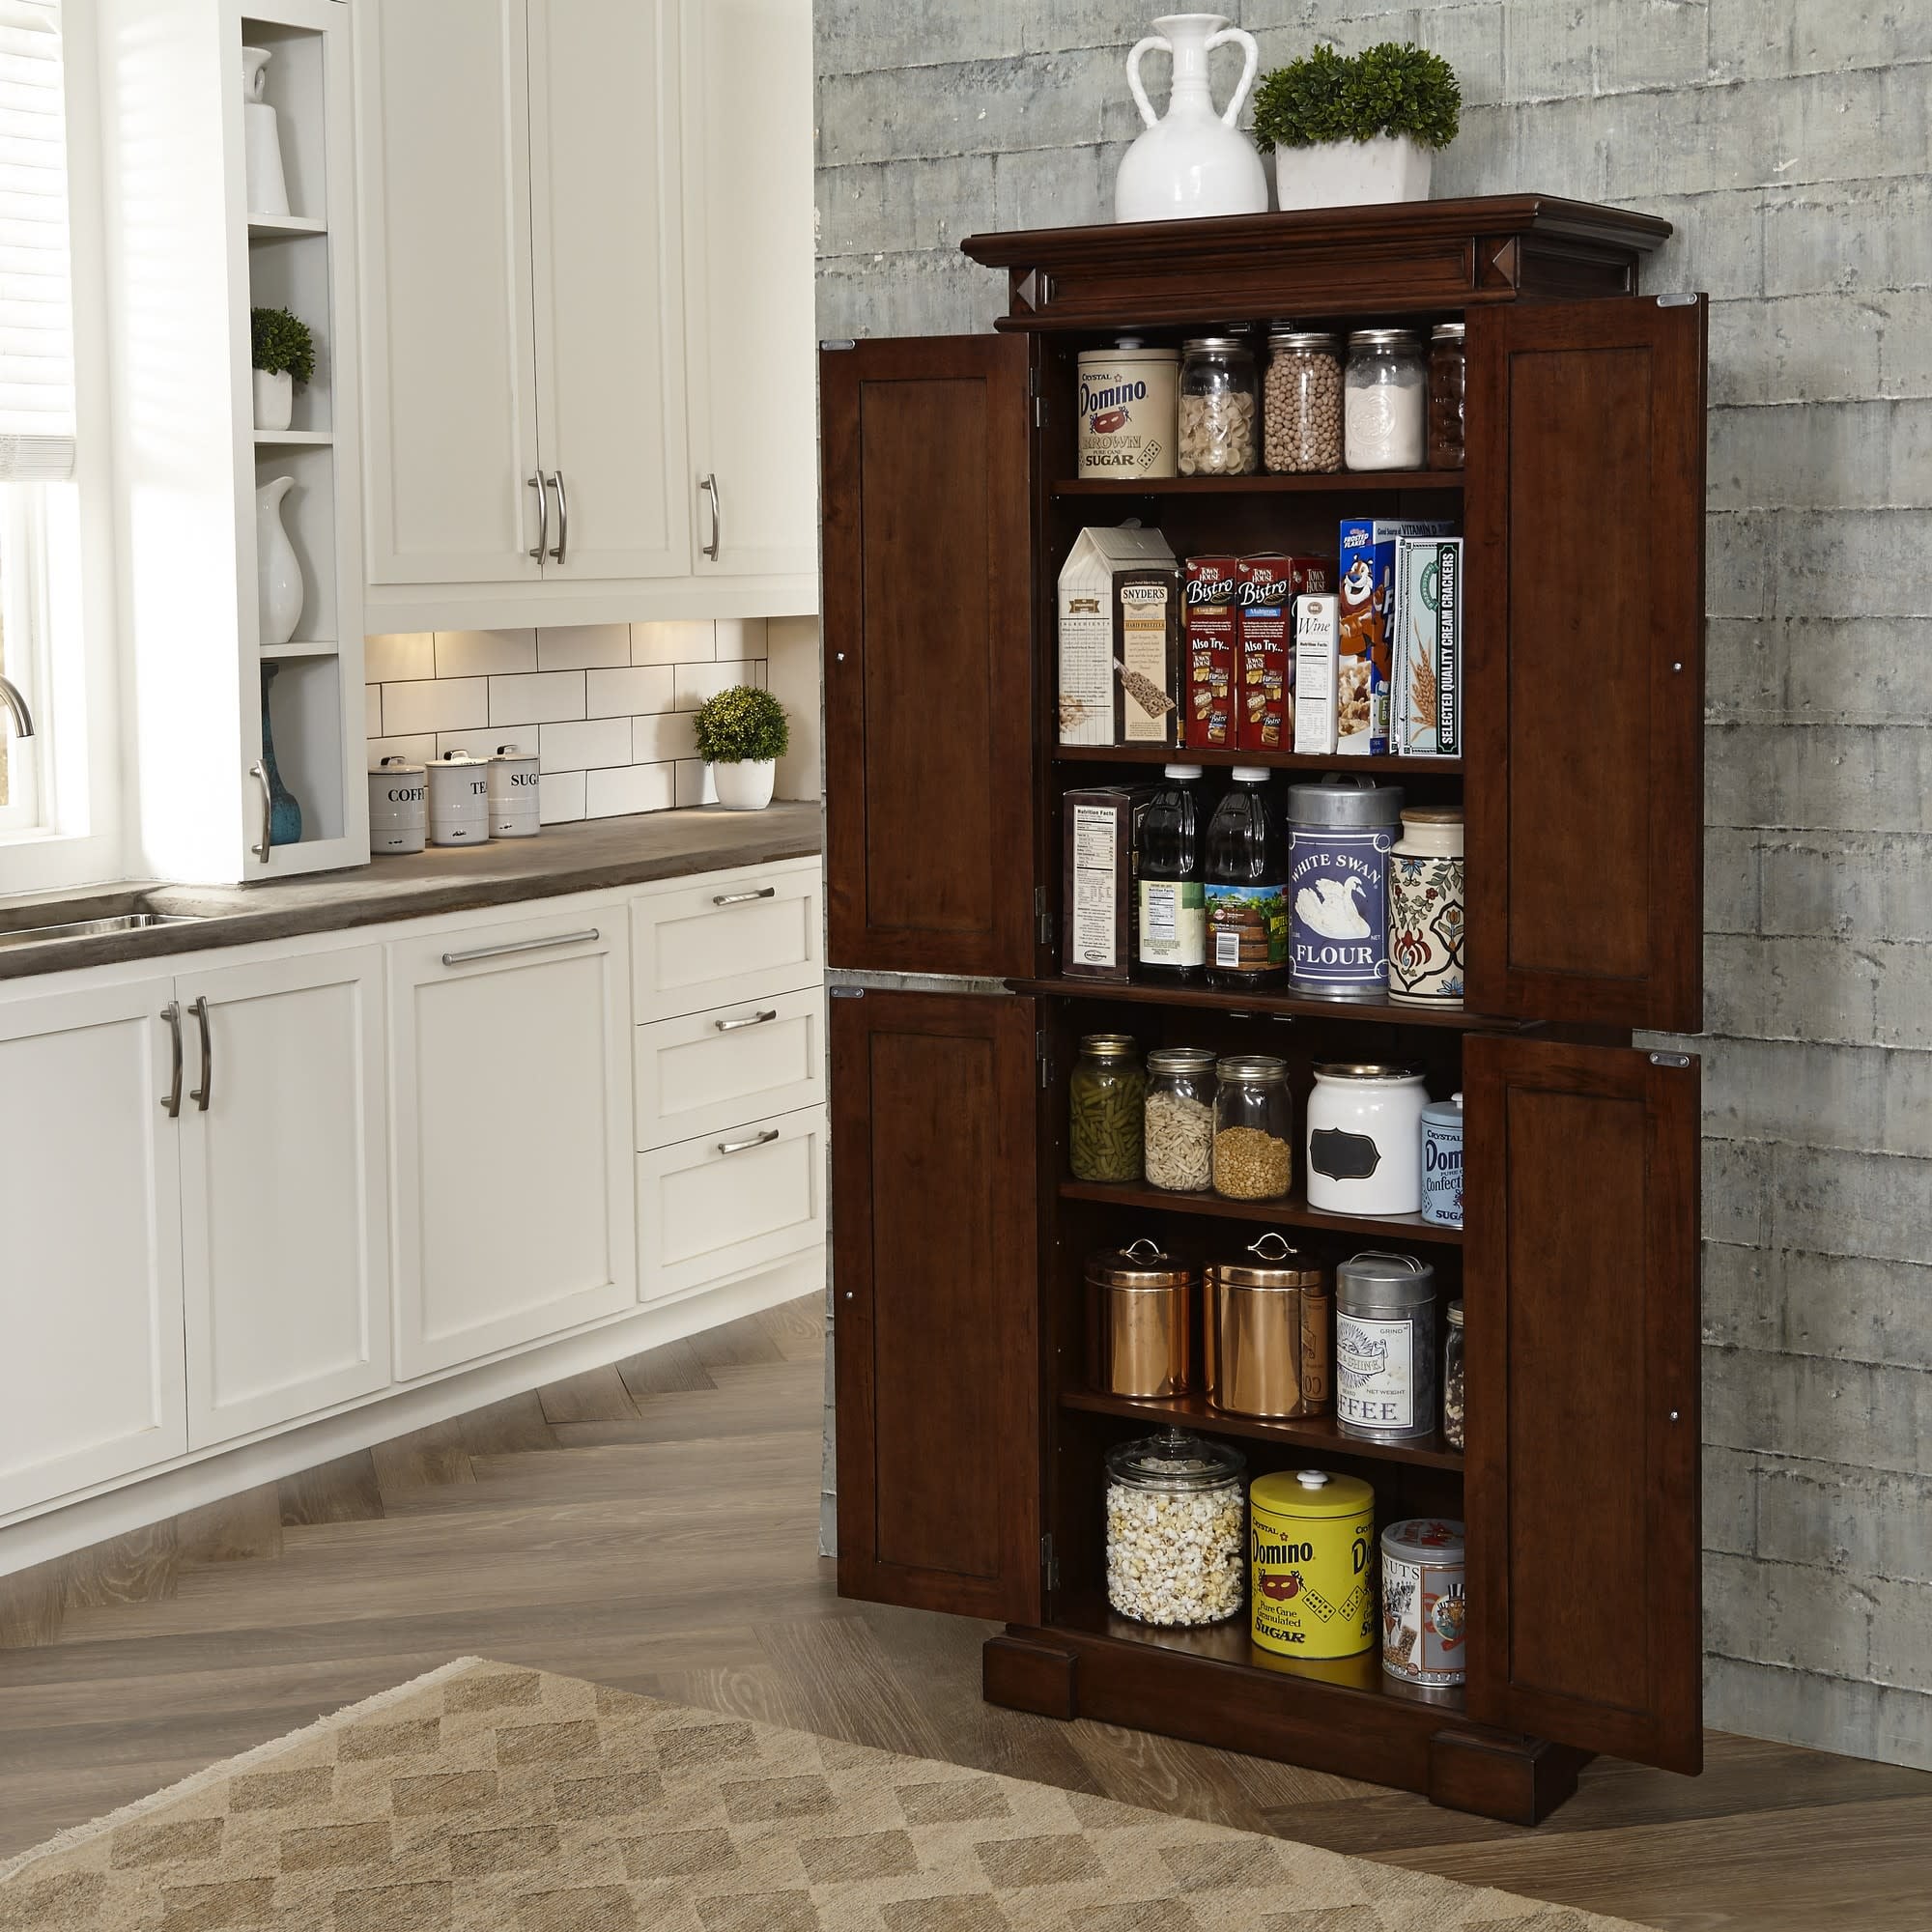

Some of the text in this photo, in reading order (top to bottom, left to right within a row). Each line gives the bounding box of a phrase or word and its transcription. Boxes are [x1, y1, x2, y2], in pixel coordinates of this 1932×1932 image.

[1082, 373, 1111, 382] CRYSTAL
[1080, 381, 1147, 418] Domino
[1081, 436, 1141, 450] BROWN
[1086, 455, 1134, 467] SUGAR
[1401, 524, 1430, 535] VITAMIN
[1307, 569, 1324, 581] TOWN
[1122, 588, 1165, 600] SNYDER'S
[1186, 578, 1234, 604] Bistro
[1238, 580, 1287, 606] Bistro
[1306, 581, 1325, 593] HOUSE
[1298, 618, 1330, 635] Wine
[1192, 639, 1208, 650] Also
[1244, 640, 1262, 652] Also
[1441, 553, 1454, 744] SELECTED QUALITY CREAM CRACKERS
[388, 788, 424, 802] COFF
[470, 781, 488, 795] TE
[1292, 853, 1380, 884] WHITE SWAN
[1296, 944, 1374, 964] FLOUR
[1427, 1129, 1463, 1142] CRYSTAL
[1425, 1140, 1463, 1172] Dom
[1348, 1358, 1381, 1371] SHINE
[1337, 1394, 1398, 1420] FFEE
[1253, 1517, 1278, 1535] CRYSTAL
[1252, 1528, 1314, 1564] Domino
[1382, 1556, 1420, 1579] NUTS
[1257, 1606, 1301, 1627] Granulated
[1260, 1601, 1297, 1617] Pure Cane
[1255, 1616, 1306, 1644] SUGAR
